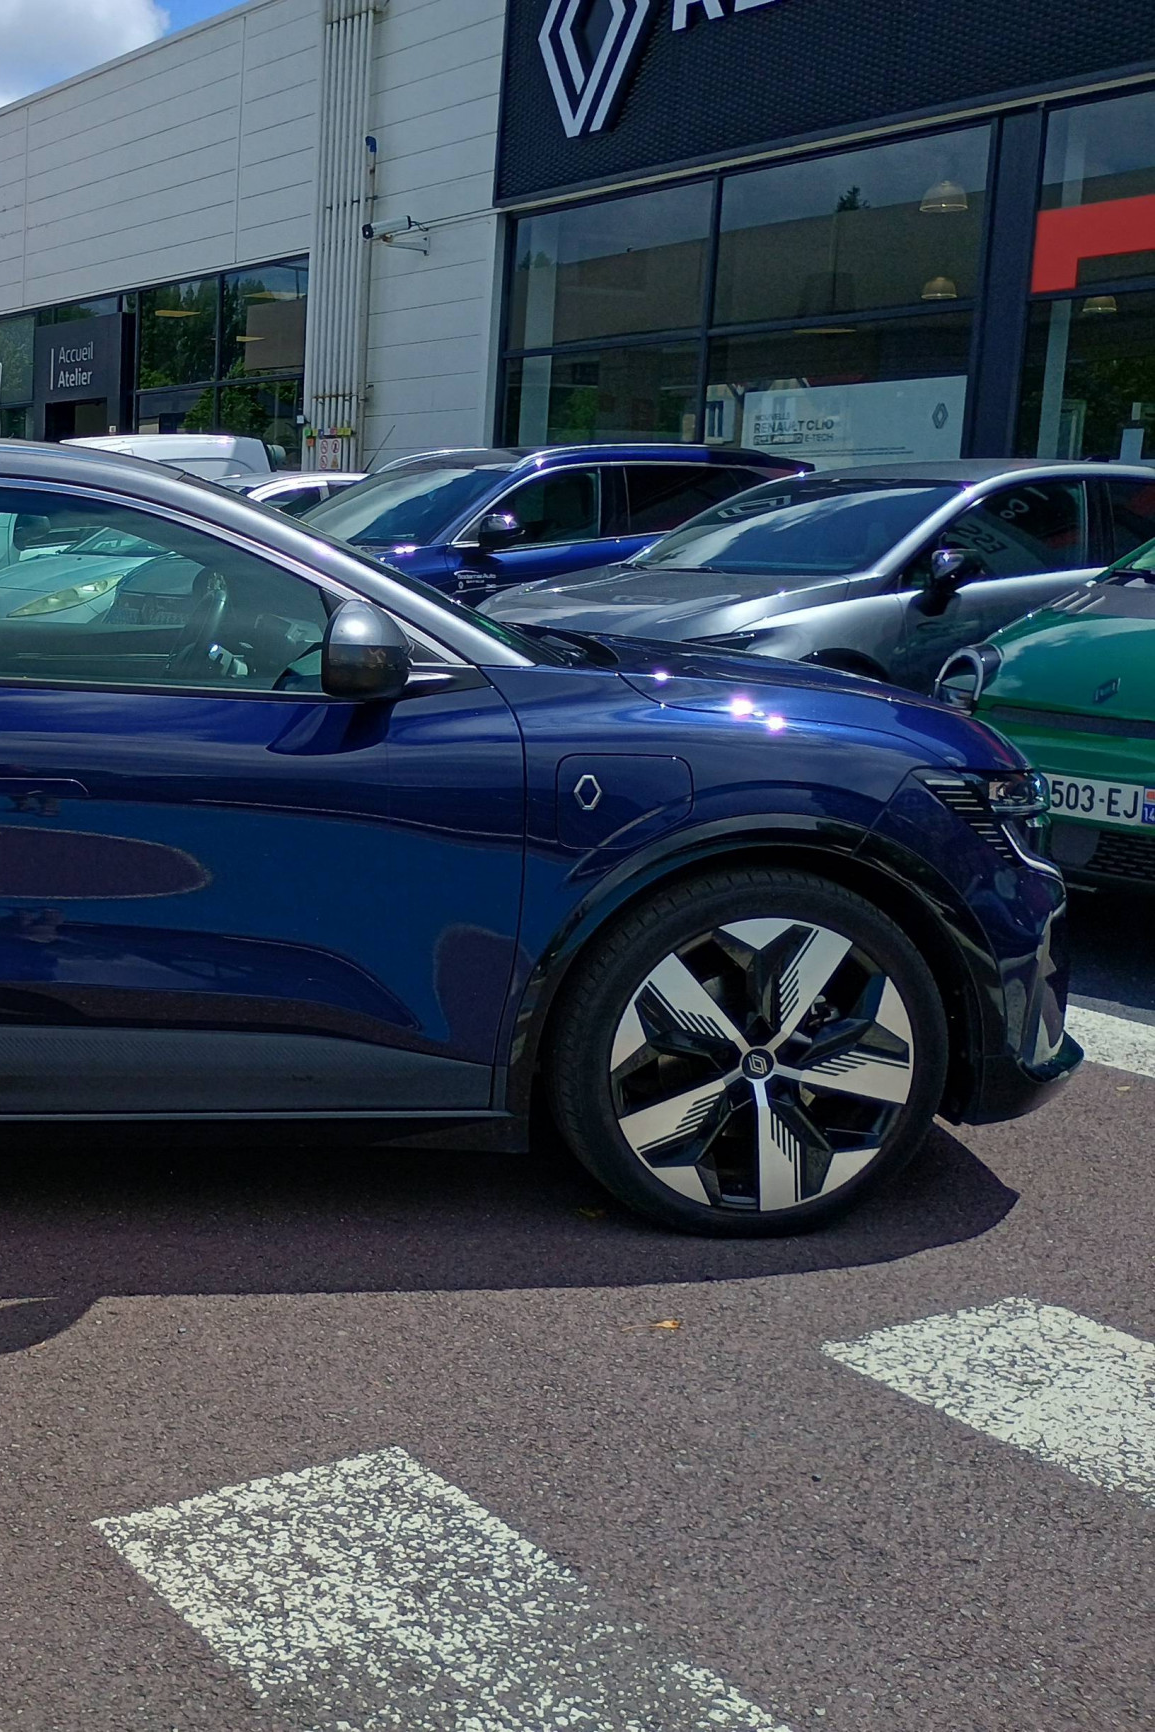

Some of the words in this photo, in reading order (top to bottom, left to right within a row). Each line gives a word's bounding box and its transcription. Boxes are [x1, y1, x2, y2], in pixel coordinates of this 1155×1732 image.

[58, 341, 94, 364] Accueil
[57, 367, 93, 388] Atelier
[806, 419, 834, 431] CLIO
